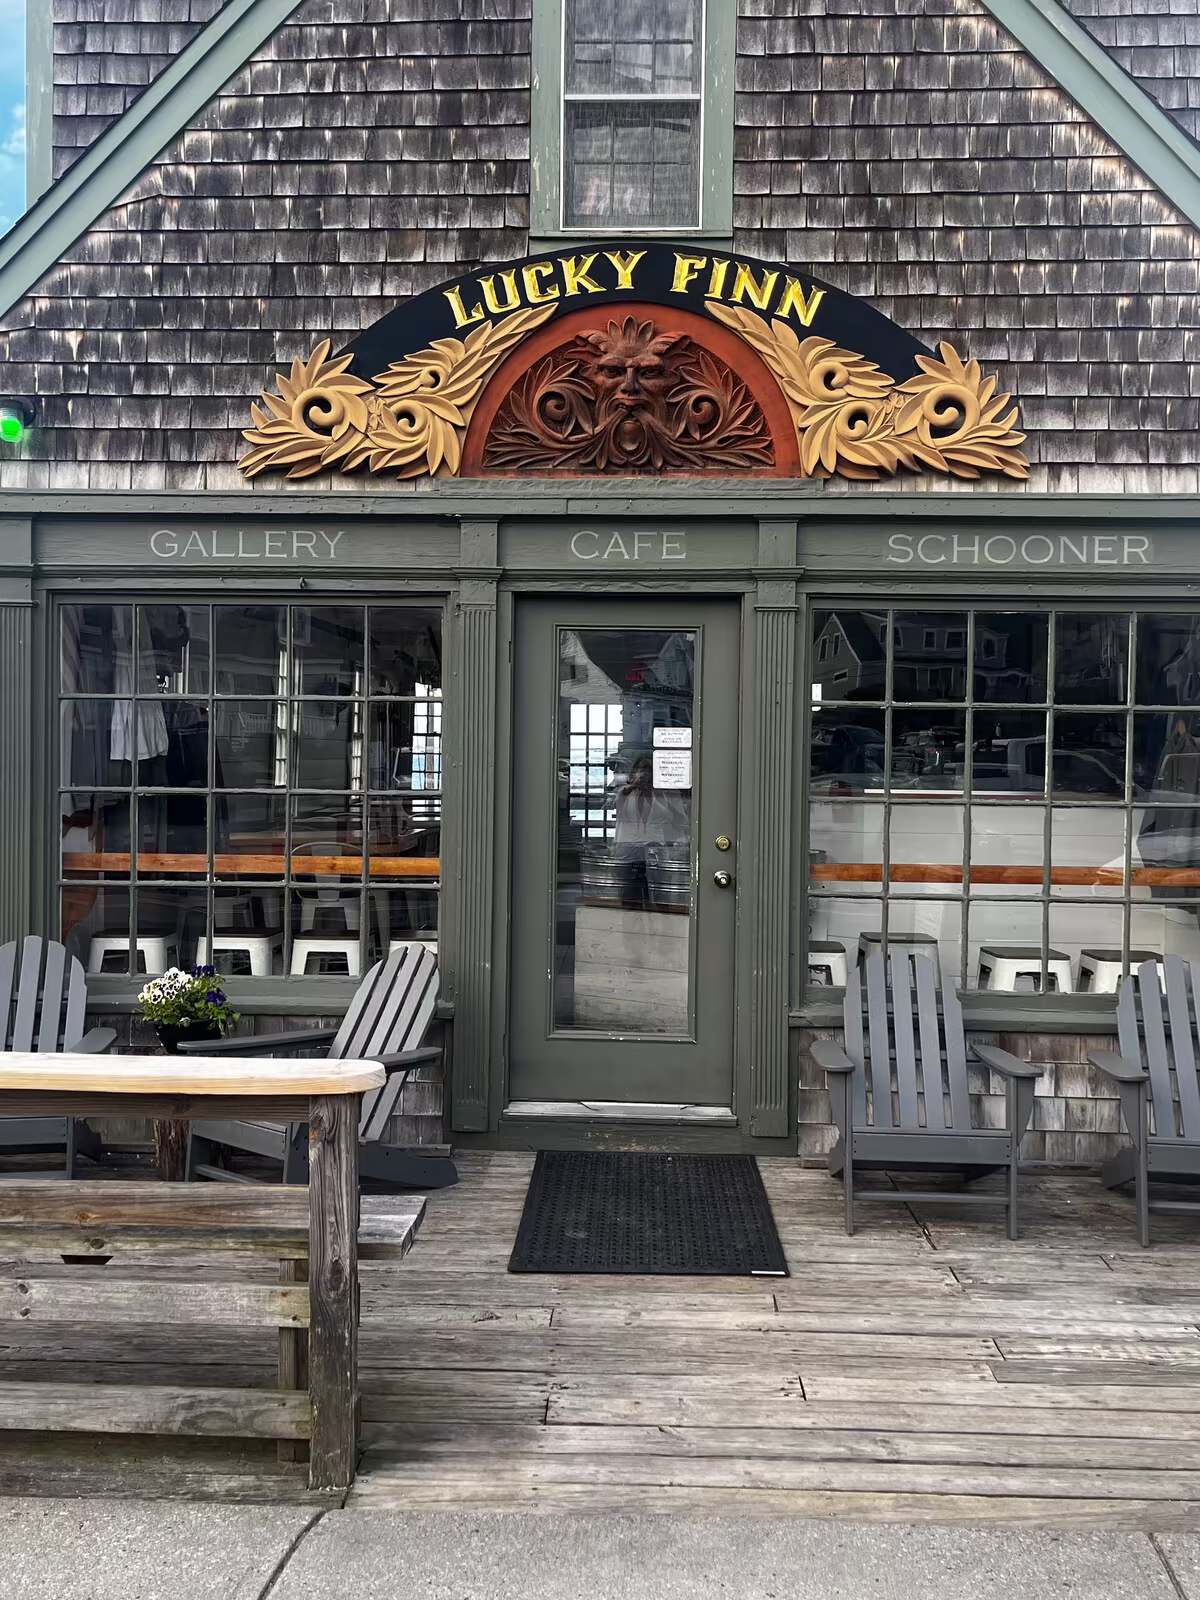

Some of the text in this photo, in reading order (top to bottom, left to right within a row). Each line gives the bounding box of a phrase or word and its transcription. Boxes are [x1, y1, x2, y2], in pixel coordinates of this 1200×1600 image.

[442, 250, 828, 330] LUCKY FINN
[149, 529, 346, 559] GALLERY
[570, 530, 687, 560] CAFE
[886, 533, 1151, 565] SCHOONER
